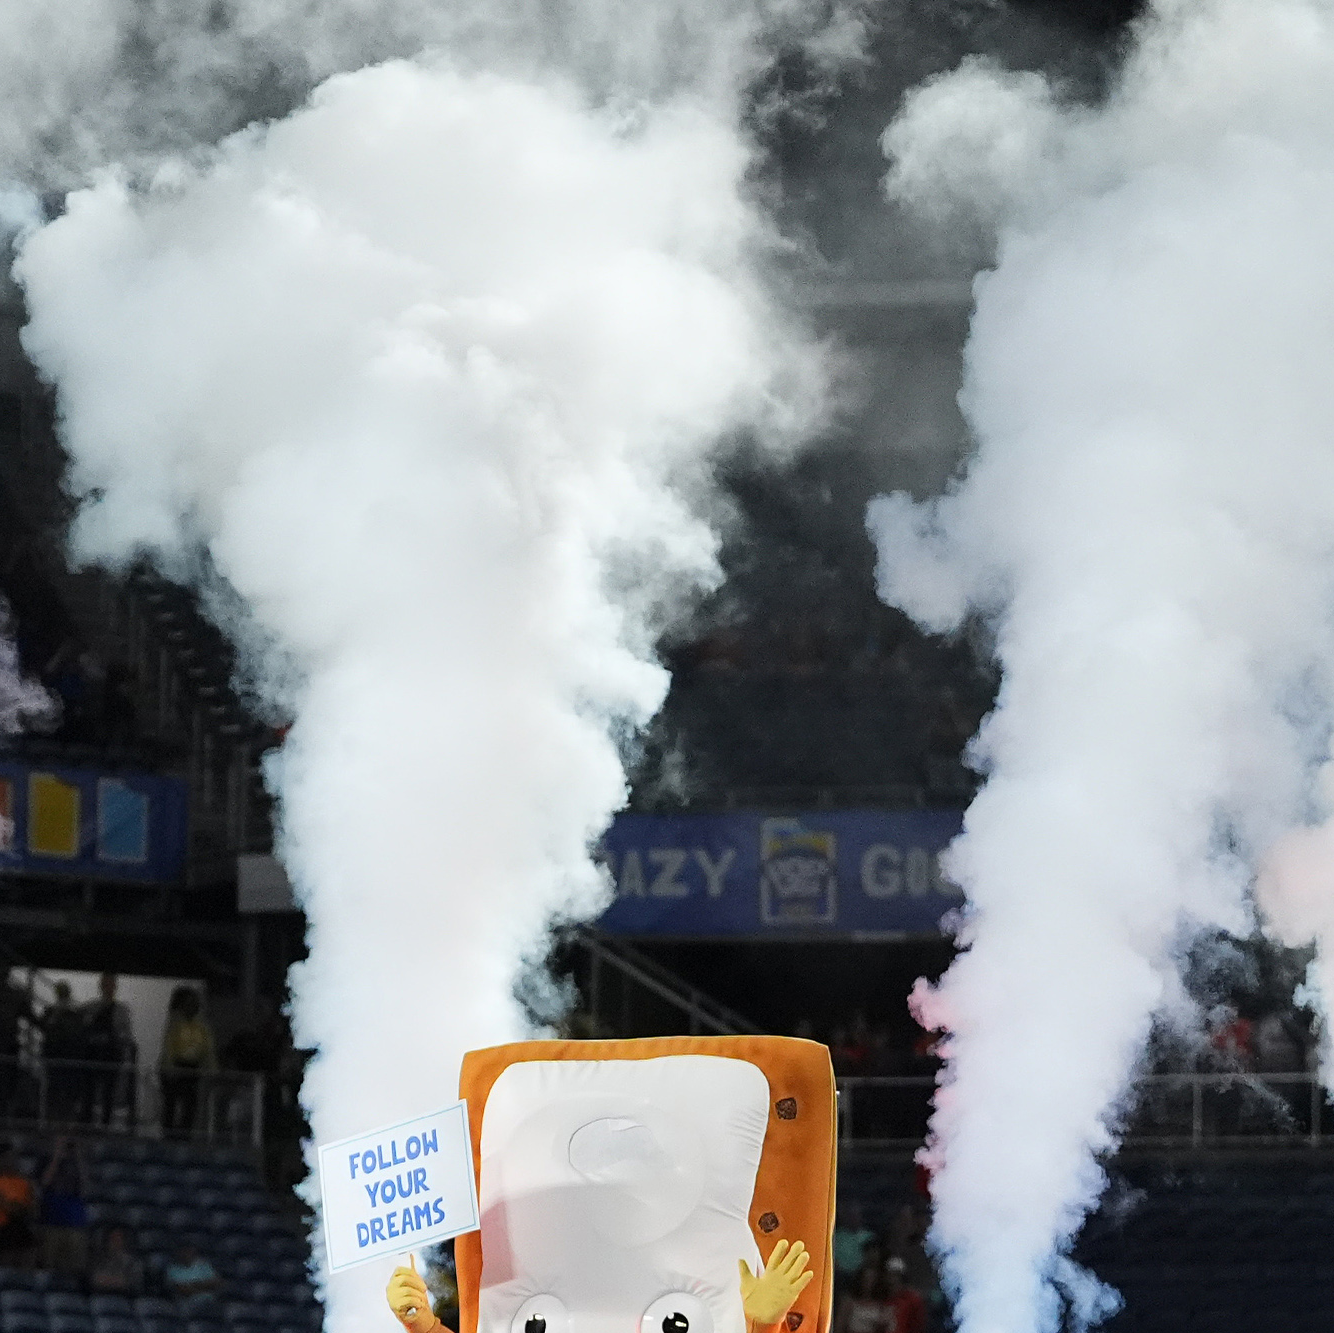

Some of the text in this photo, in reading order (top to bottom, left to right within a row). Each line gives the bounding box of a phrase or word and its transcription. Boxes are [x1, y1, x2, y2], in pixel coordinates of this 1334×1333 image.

[605, 846, 737, 898] AZY
[348, 1128, 438, 1180] FOLLOW
[364, 1167, 430, 1208] YOUR
[356, 1196, 445, 1248] DREAMS
